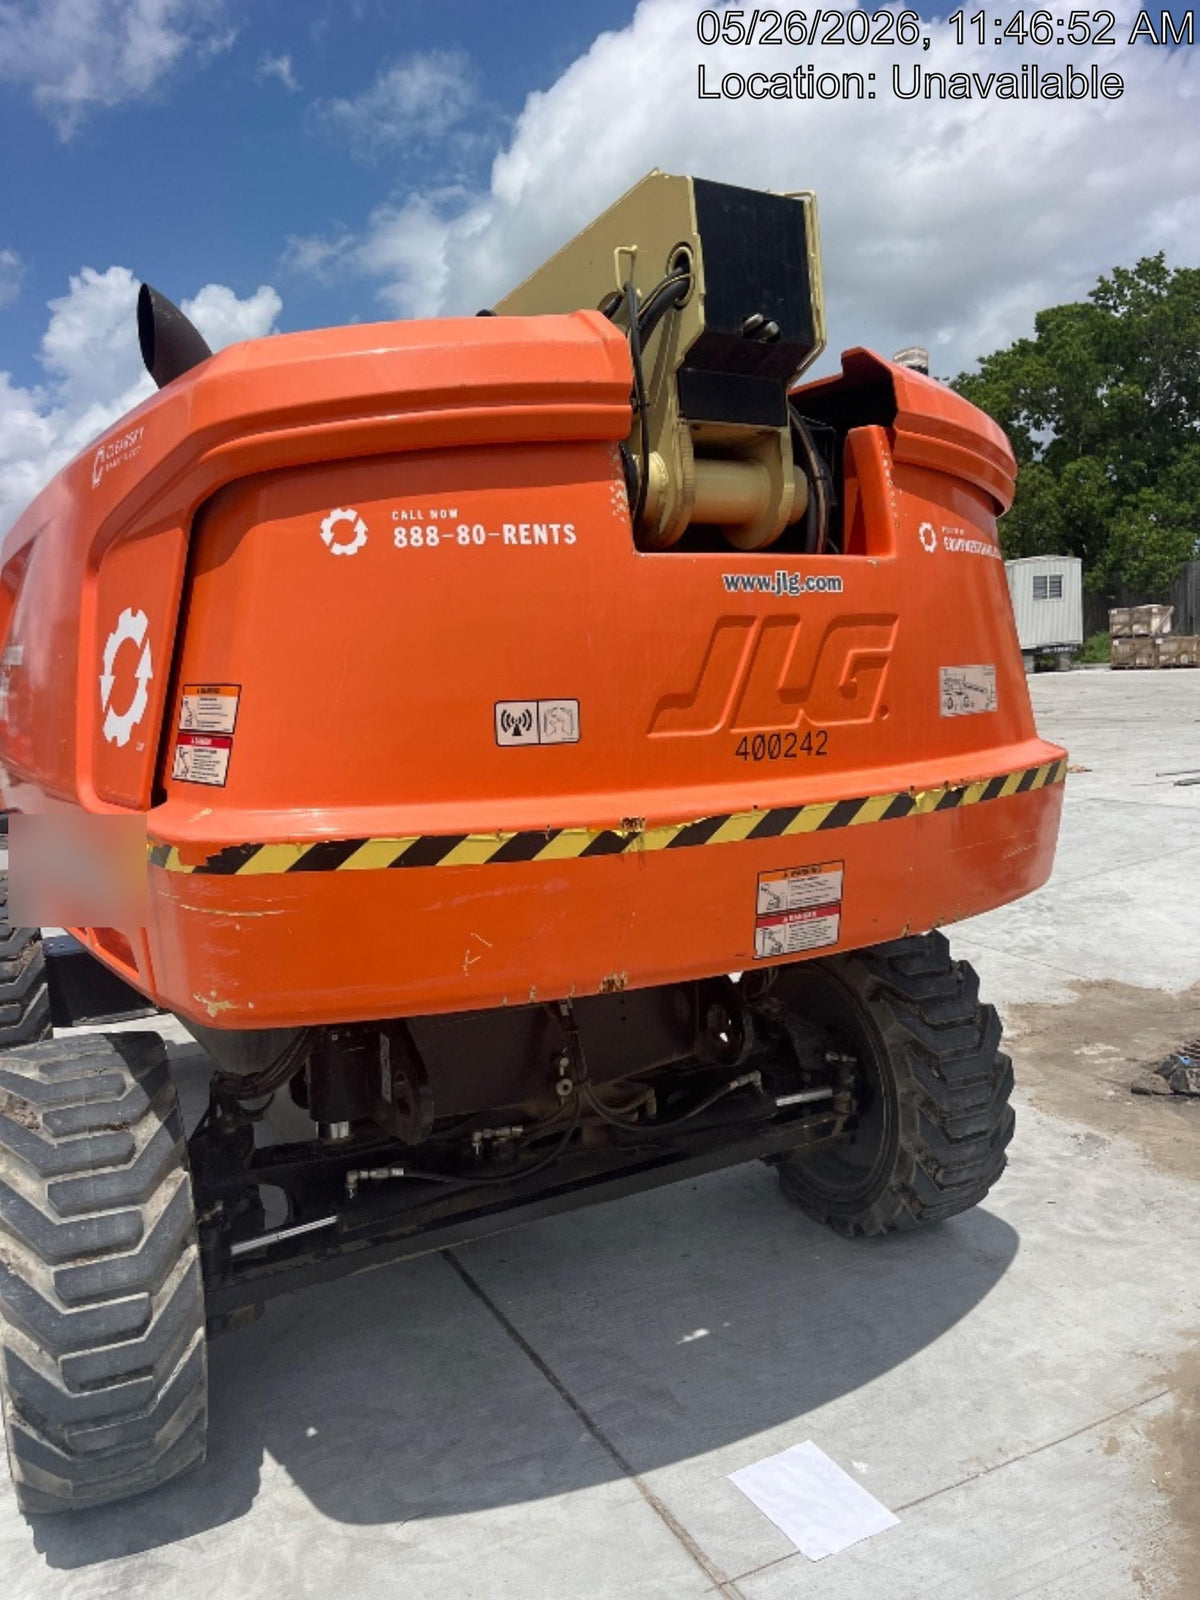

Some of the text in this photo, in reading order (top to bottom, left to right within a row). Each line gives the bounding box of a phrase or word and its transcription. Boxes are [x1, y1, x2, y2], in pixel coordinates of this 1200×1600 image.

[392, 508, 458, 520] CALL NOW
[393, 523, 577, 549] 888-80-RENTS
[722, 570, 844, 597] www.jlg.com
[647, 613, 900, 738] JLG
[735, 730, 829, 761] 400242
